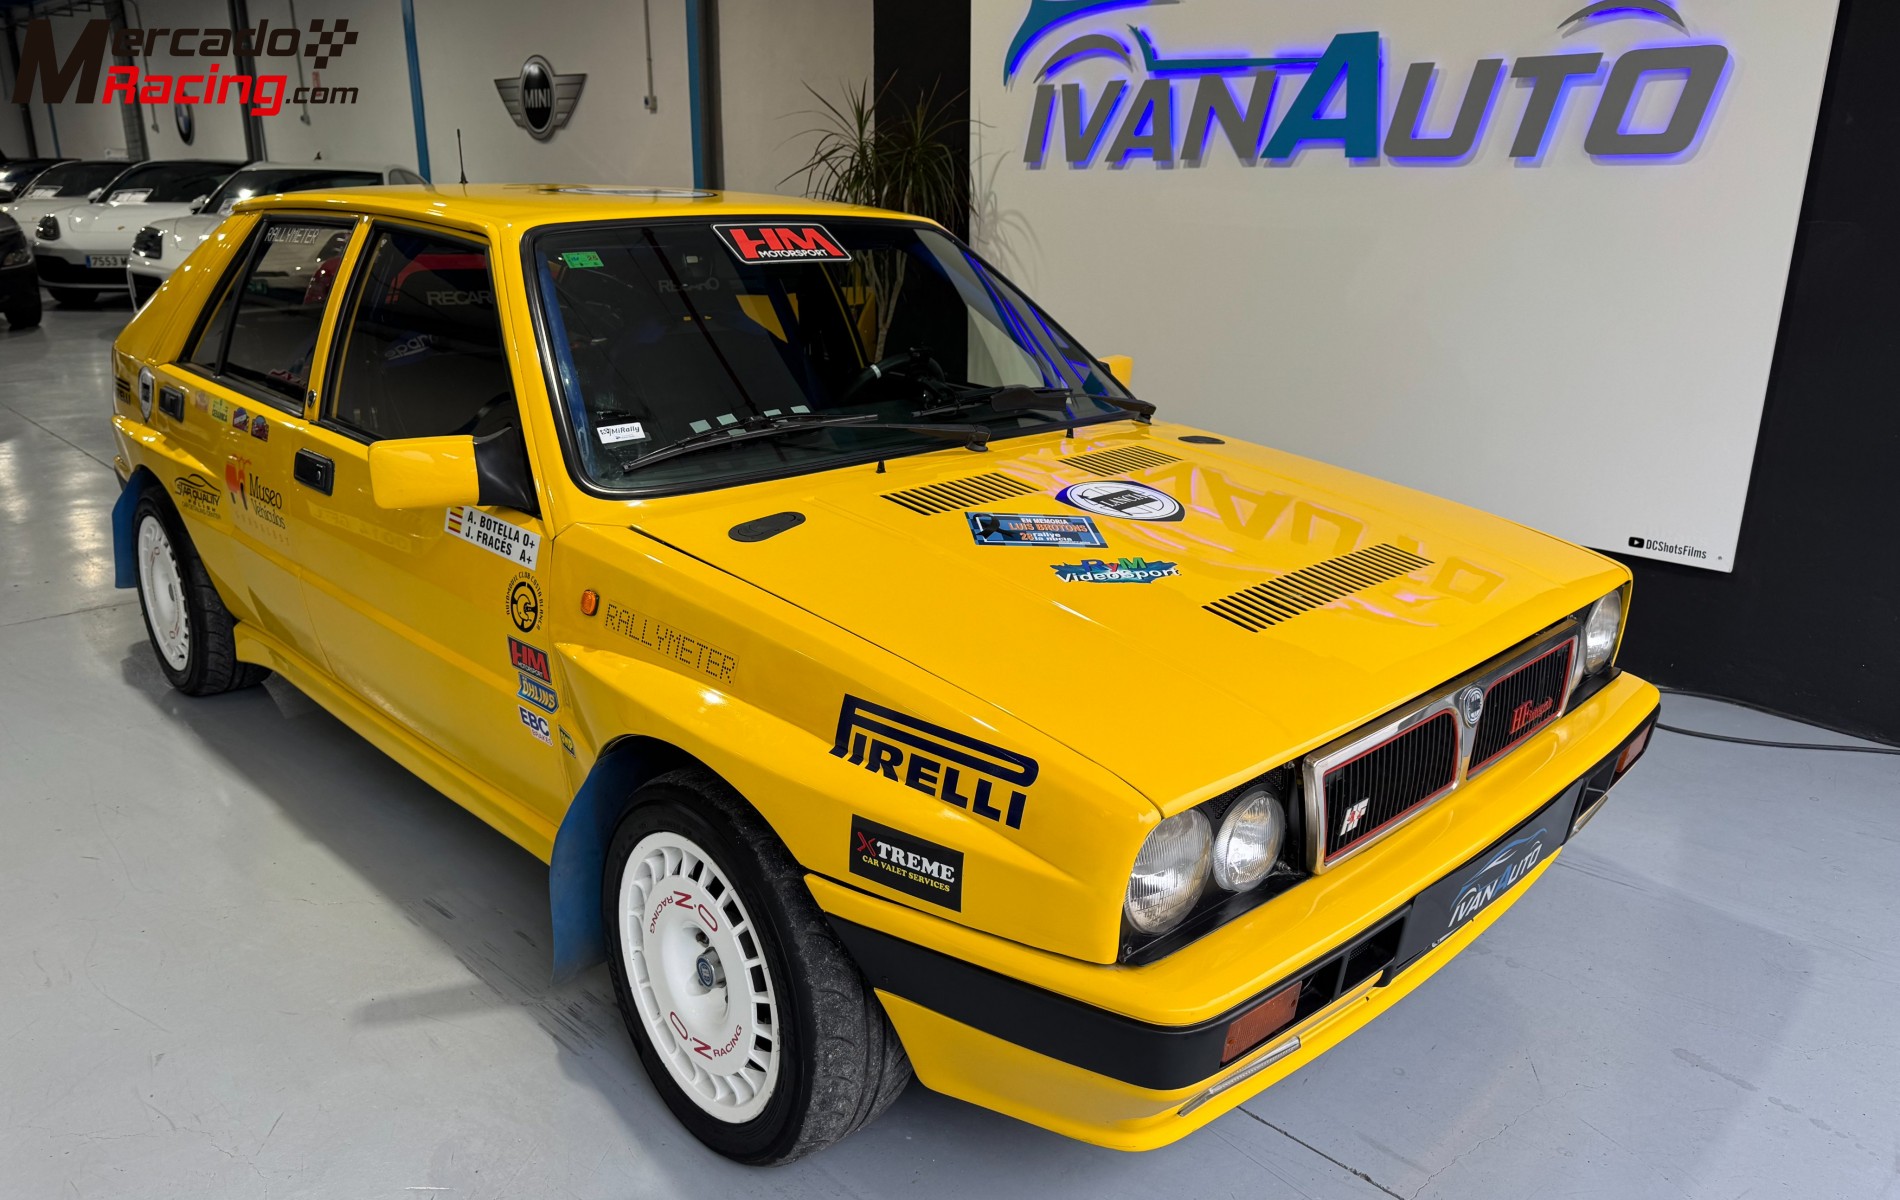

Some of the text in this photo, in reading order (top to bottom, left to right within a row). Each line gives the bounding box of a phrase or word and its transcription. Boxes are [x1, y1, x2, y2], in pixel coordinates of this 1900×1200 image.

[524, 88, 551, 109] MINI
[264, 226, 320, 244] RALLYMETER
[729, 228, 845, 259] HM
[92, 256, 118, 266] 7553
[758, 249, 829, 258] MOTORSPORT
[611, 425, 641, 435] MiRally
[249, 472, 283, 510] Museo
[479, 515, 520, 543] BOTELLA
[1008, 522, 1089, 533] LUIS BROTONS
[1033, 518, 1069, 526] MEMORIA
[476, 530, 513, 556] FRACÉS
[519, 549, 532, 565] A+
[1645, 539, 1707, 560] DCShotsFilms
[1081, 557, 1148, 574] RyM
[604, 603, 736, 684] RALLYMETER
[511, 640, 550, 681] HM
[517, 661, 544, 678] MOTORSPORT
[518, 706, 550, 737] EBC
[531, 728, 554, 747] BRAKES
[828, 693, 1040, 830] PIRELLI
[856, 831, 956, 884] XTREME
[862, 854, 951, 893] CAR VALET SERVICES
[649, 895, 674, 935] RACING
[712, 1024, 743, 1058] RACING
